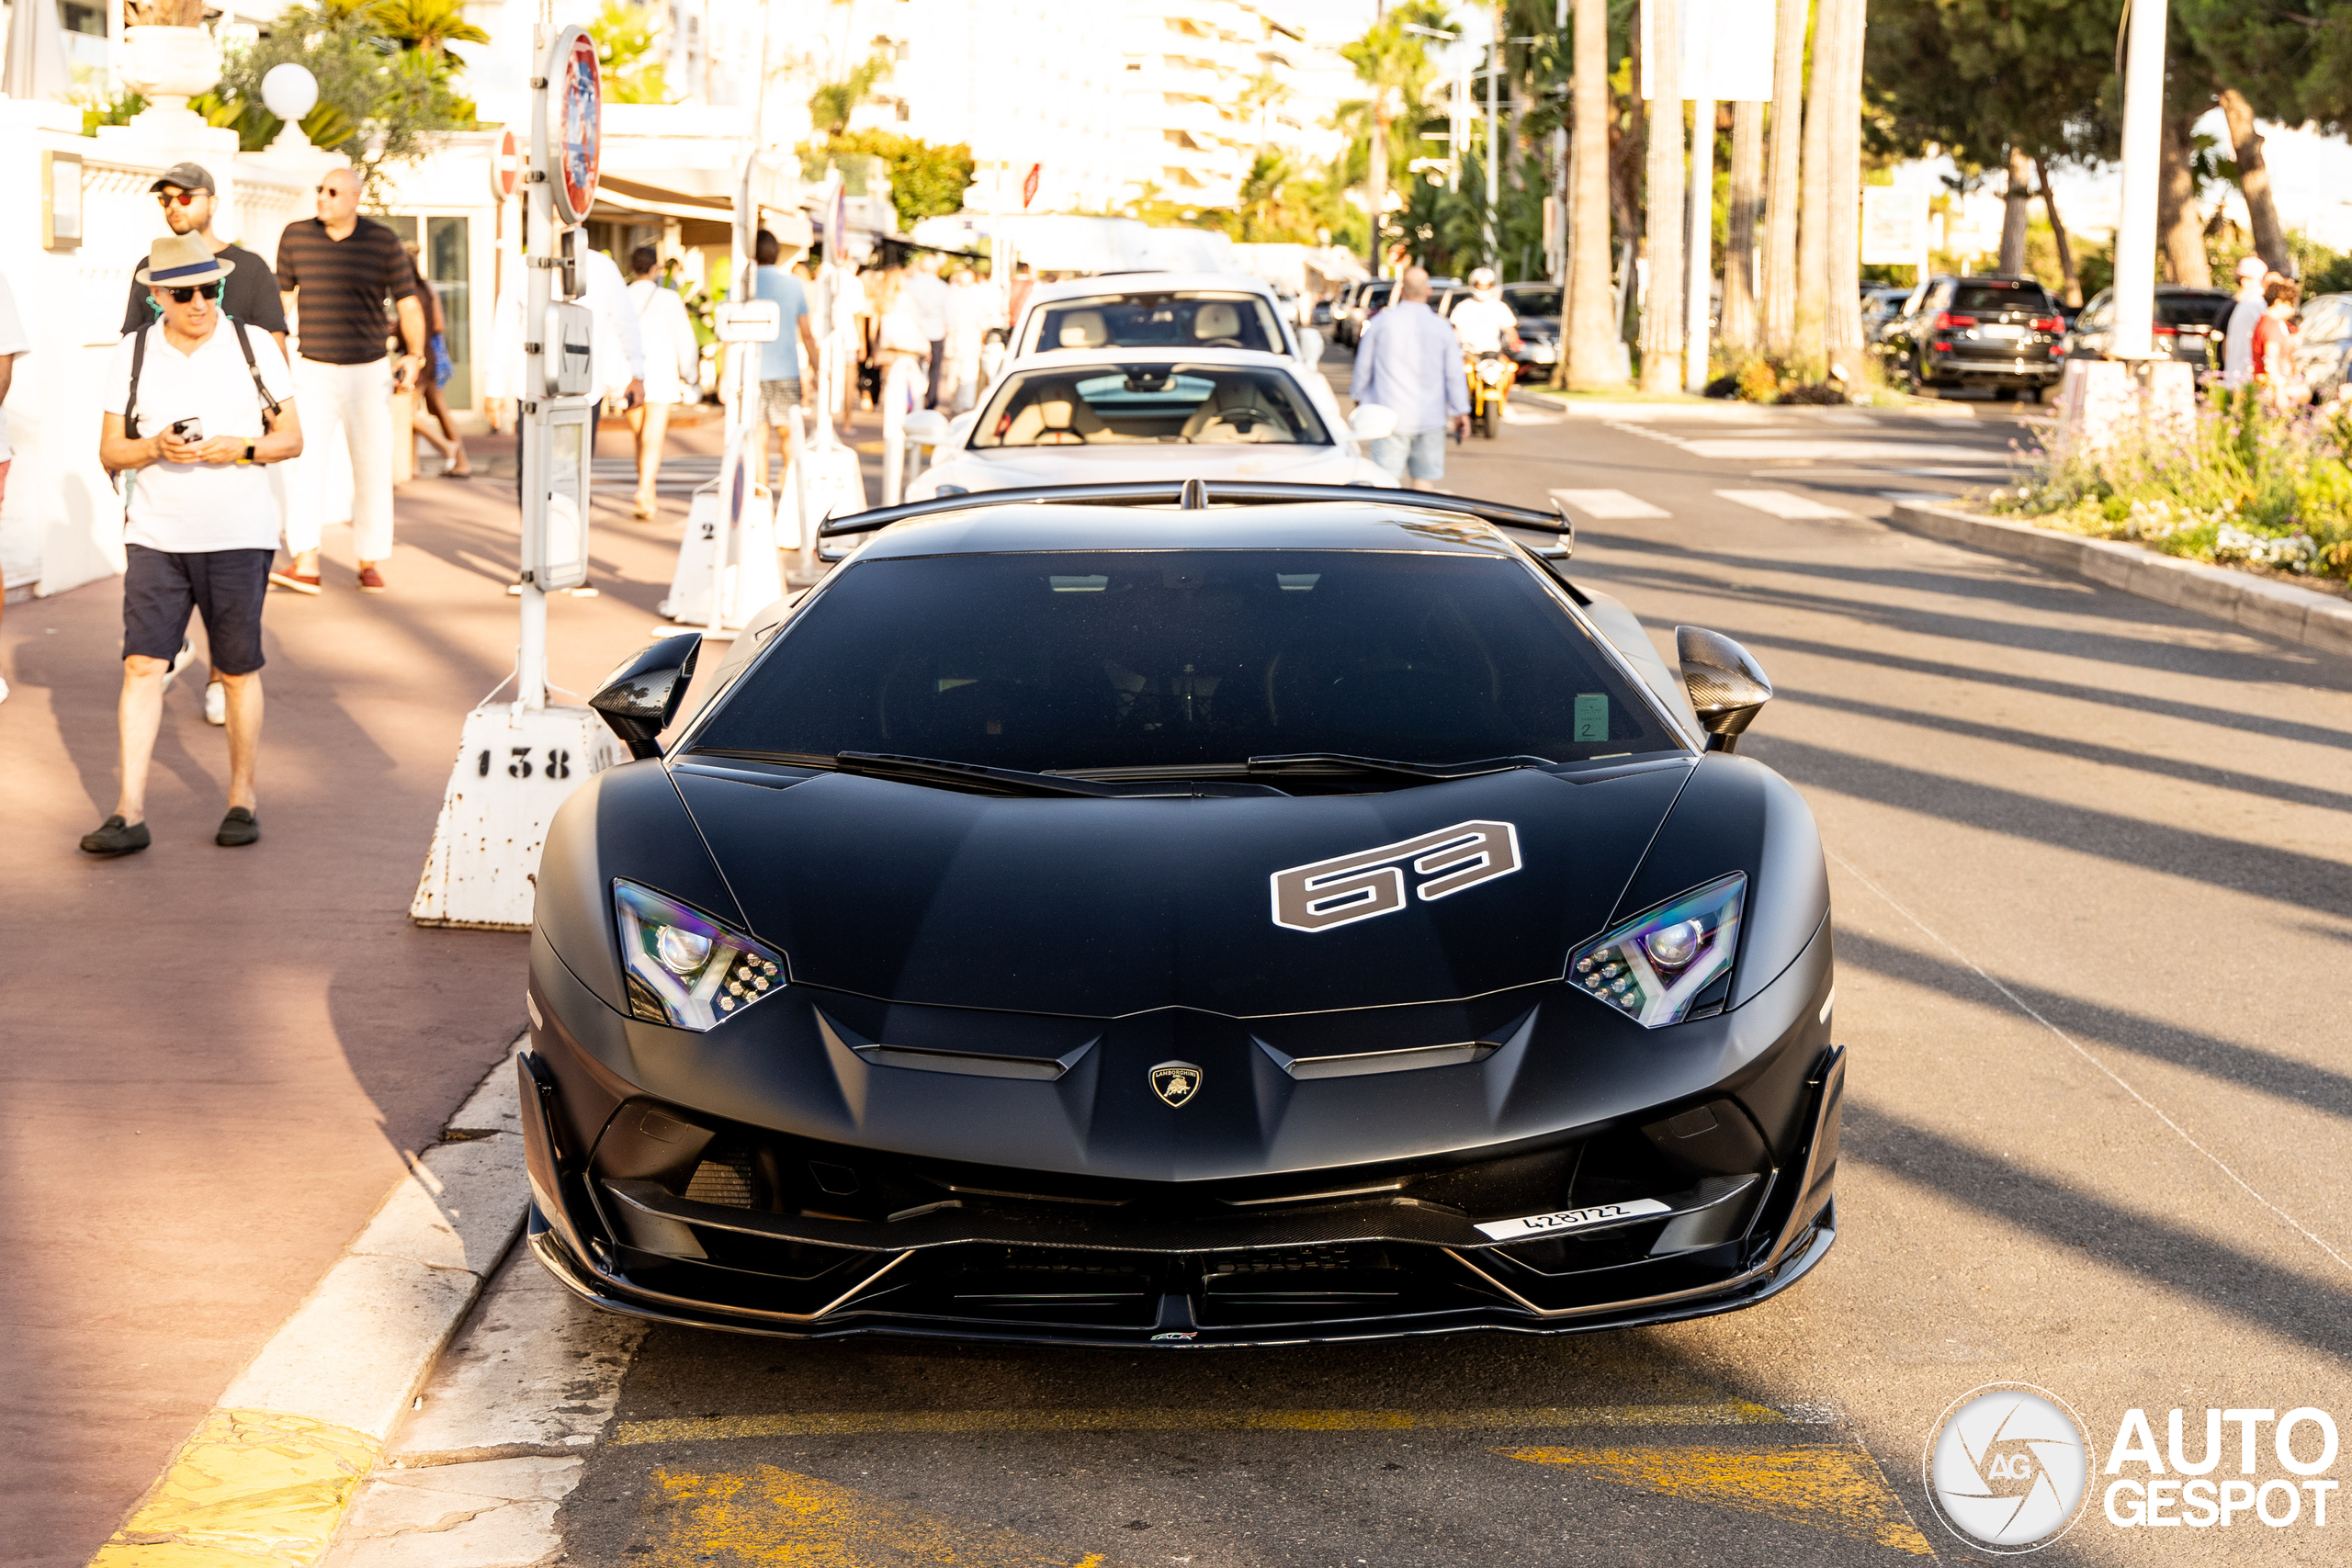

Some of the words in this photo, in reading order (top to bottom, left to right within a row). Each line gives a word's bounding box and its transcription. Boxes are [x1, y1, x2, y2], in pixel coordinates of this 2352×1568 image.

[702, 523, 715, 540] 2
[1581, 724, 1596, 737] 2
[478, 747, 571, 779] 138
[1270, 819, 1522, 933] 63
[1155, 1069, 1196, 1077] LAMBORGHINI
[1521, 1205, 1631, 1229] 428722
